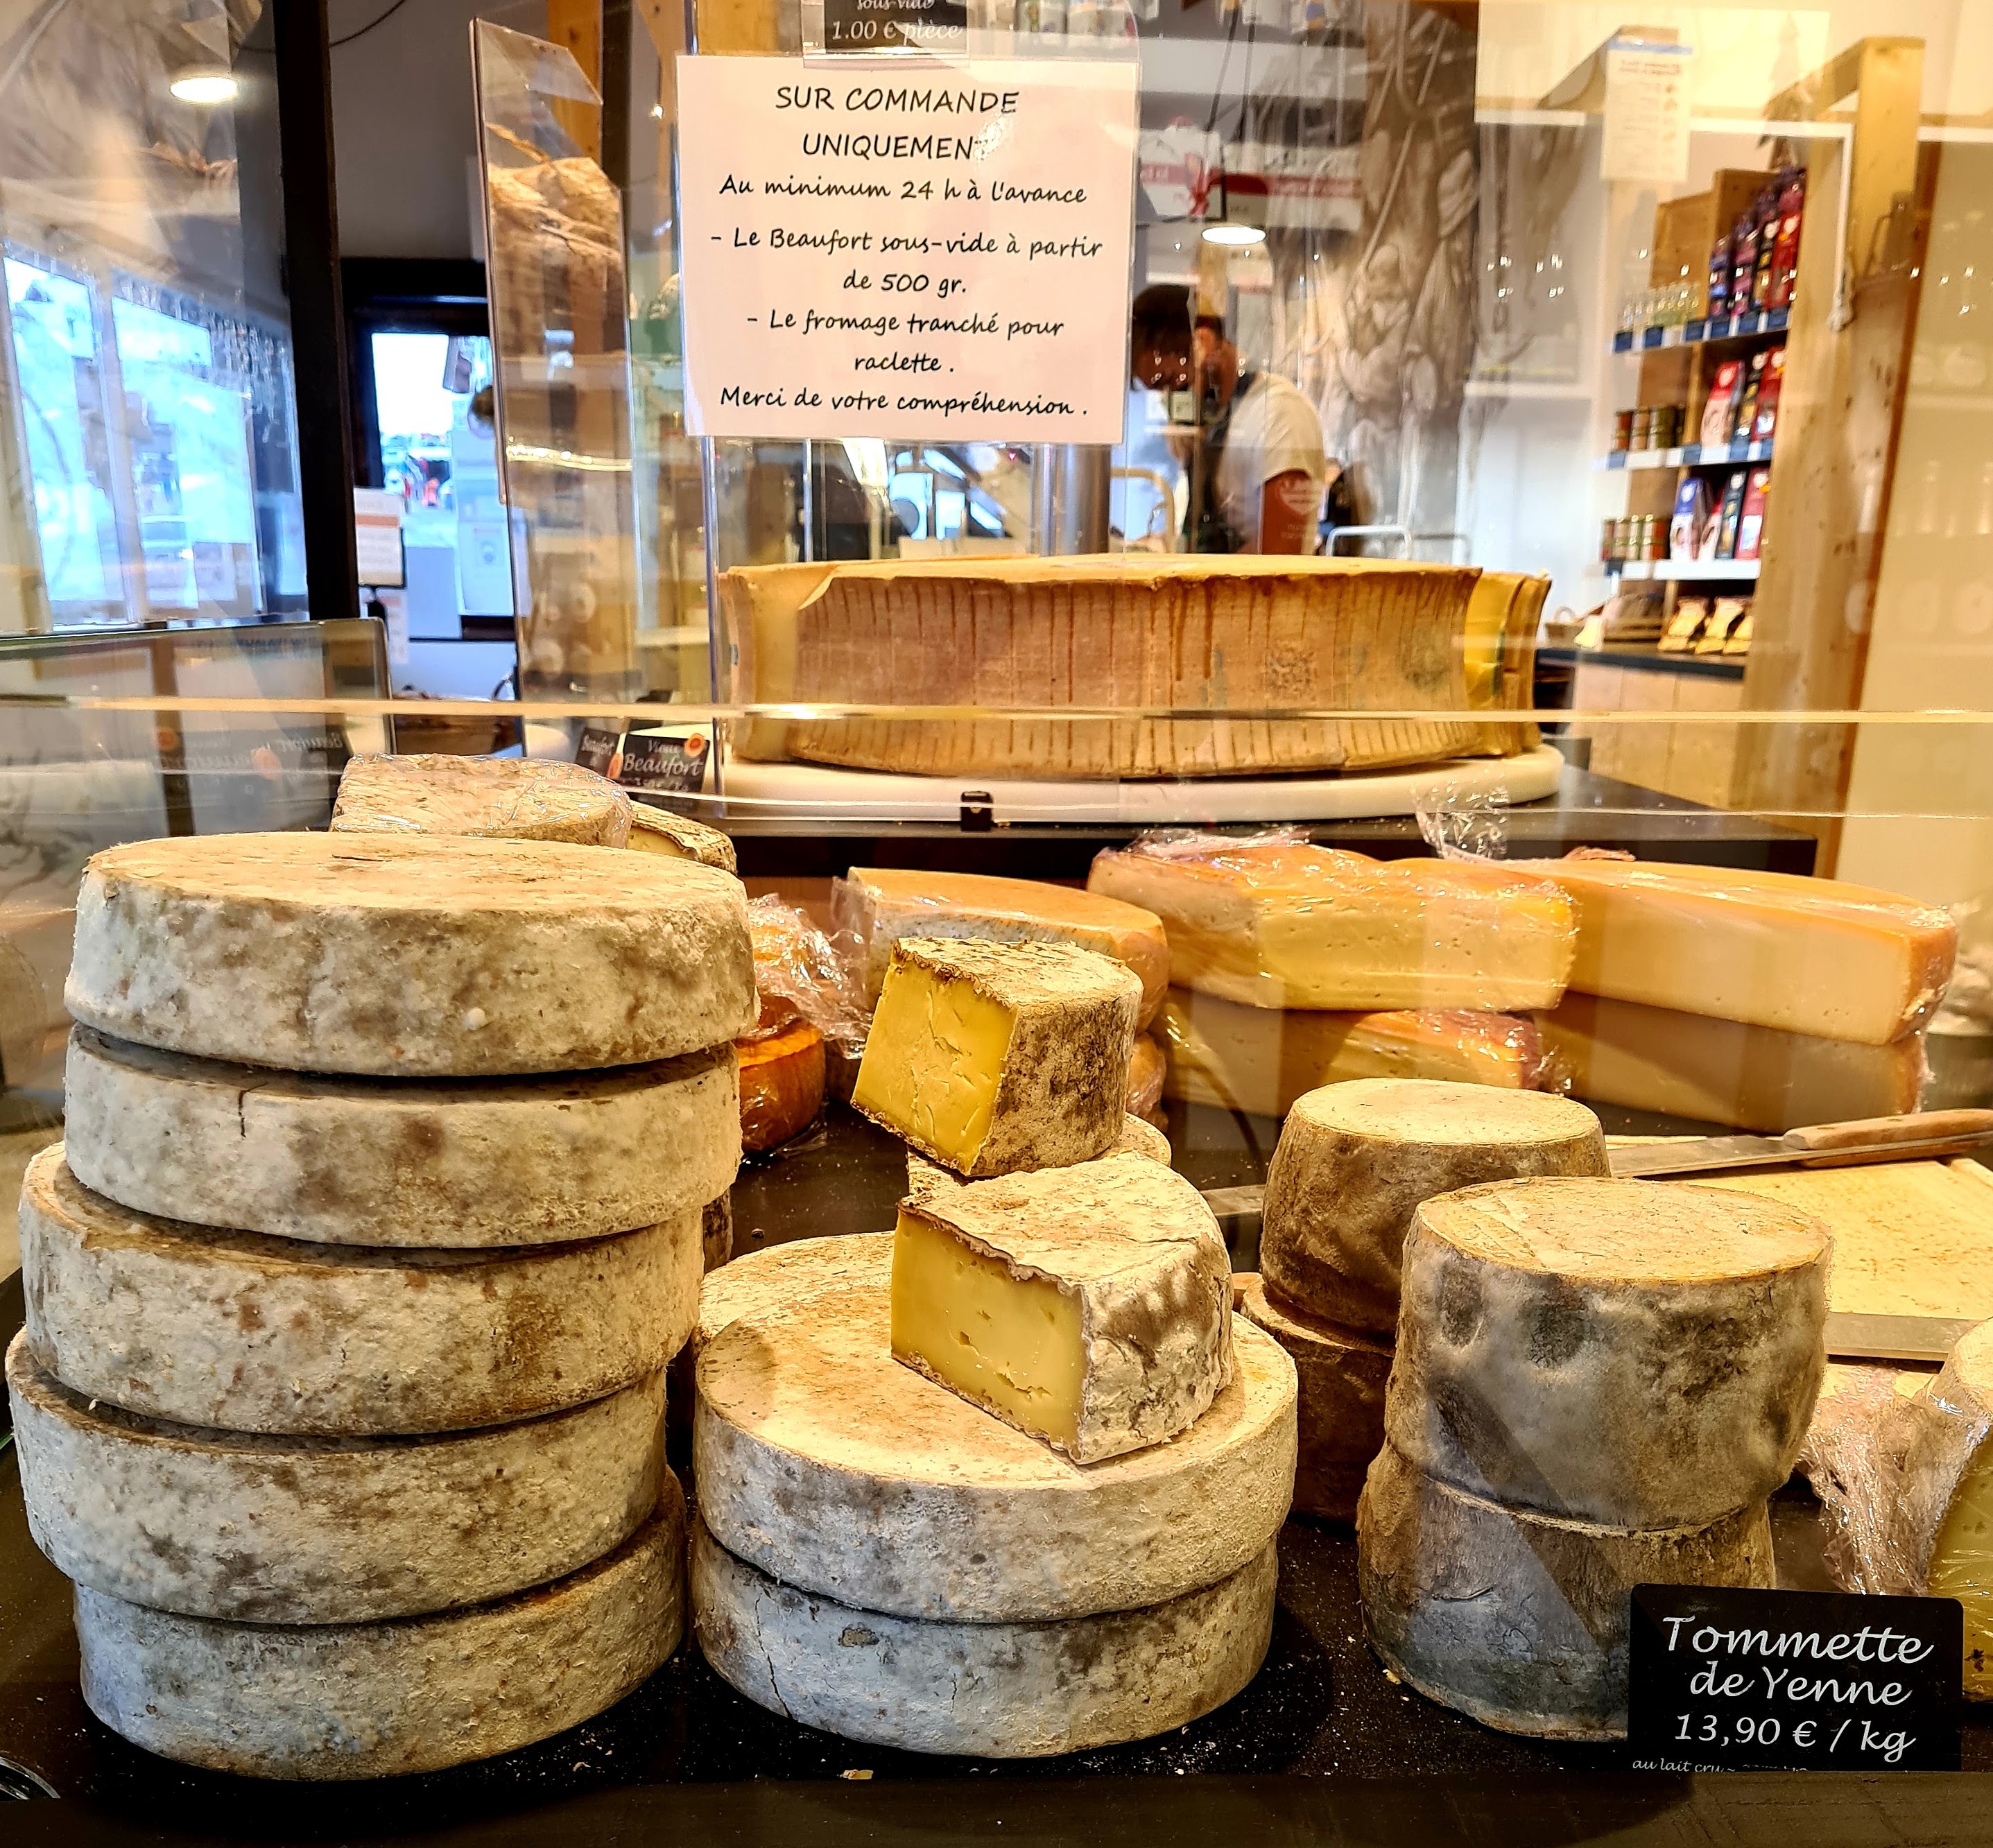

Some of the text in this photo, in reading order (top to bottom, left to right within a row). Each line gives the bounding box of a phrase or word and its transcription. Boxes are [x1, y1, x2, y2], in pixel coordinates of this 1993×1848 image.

[832, 20, 877, 40] 1.00
[904, 17, 963, 46] pièce
[775, 85, 1019, 114] SUR COMMANDE
[718, 174, 1087, 204] Au minimum 24 h à l'avance
[734, 227, 761, 248] Le
[770, 227, 873, 256] Beaufort
[879, 232, 999, 254] sous-vide
[1006, 232, 1021, 254] à
[1029, 235, 1103, 261] partir
[843, 268, 966, 299] de 500 gr.
[770, 309, 797, 329] Le
[802, 309, 900, 336] fromage
[906, 312, 999, 334] tranché
[1007, 321, 1064, 341] pour
[854, 351, 942, 374] raclette
[721, 386, 787, 407] Merci
[793, 386, 822, 407] de
[831, 390, 889, 411] votre
[897, 390, 1075, 417] compréhension
[623, 752, 704, 777] Beaufort
[1662, 1615, 1935, 1665] Tommette
[1690, 1660, 1912, 1706] de Yenne
[1675, 1713, 1917, 1763] 13,90 € / kg
[1632, 1759, 1658, 1770] au
[1659, 1758, 1693, 1772] lait
